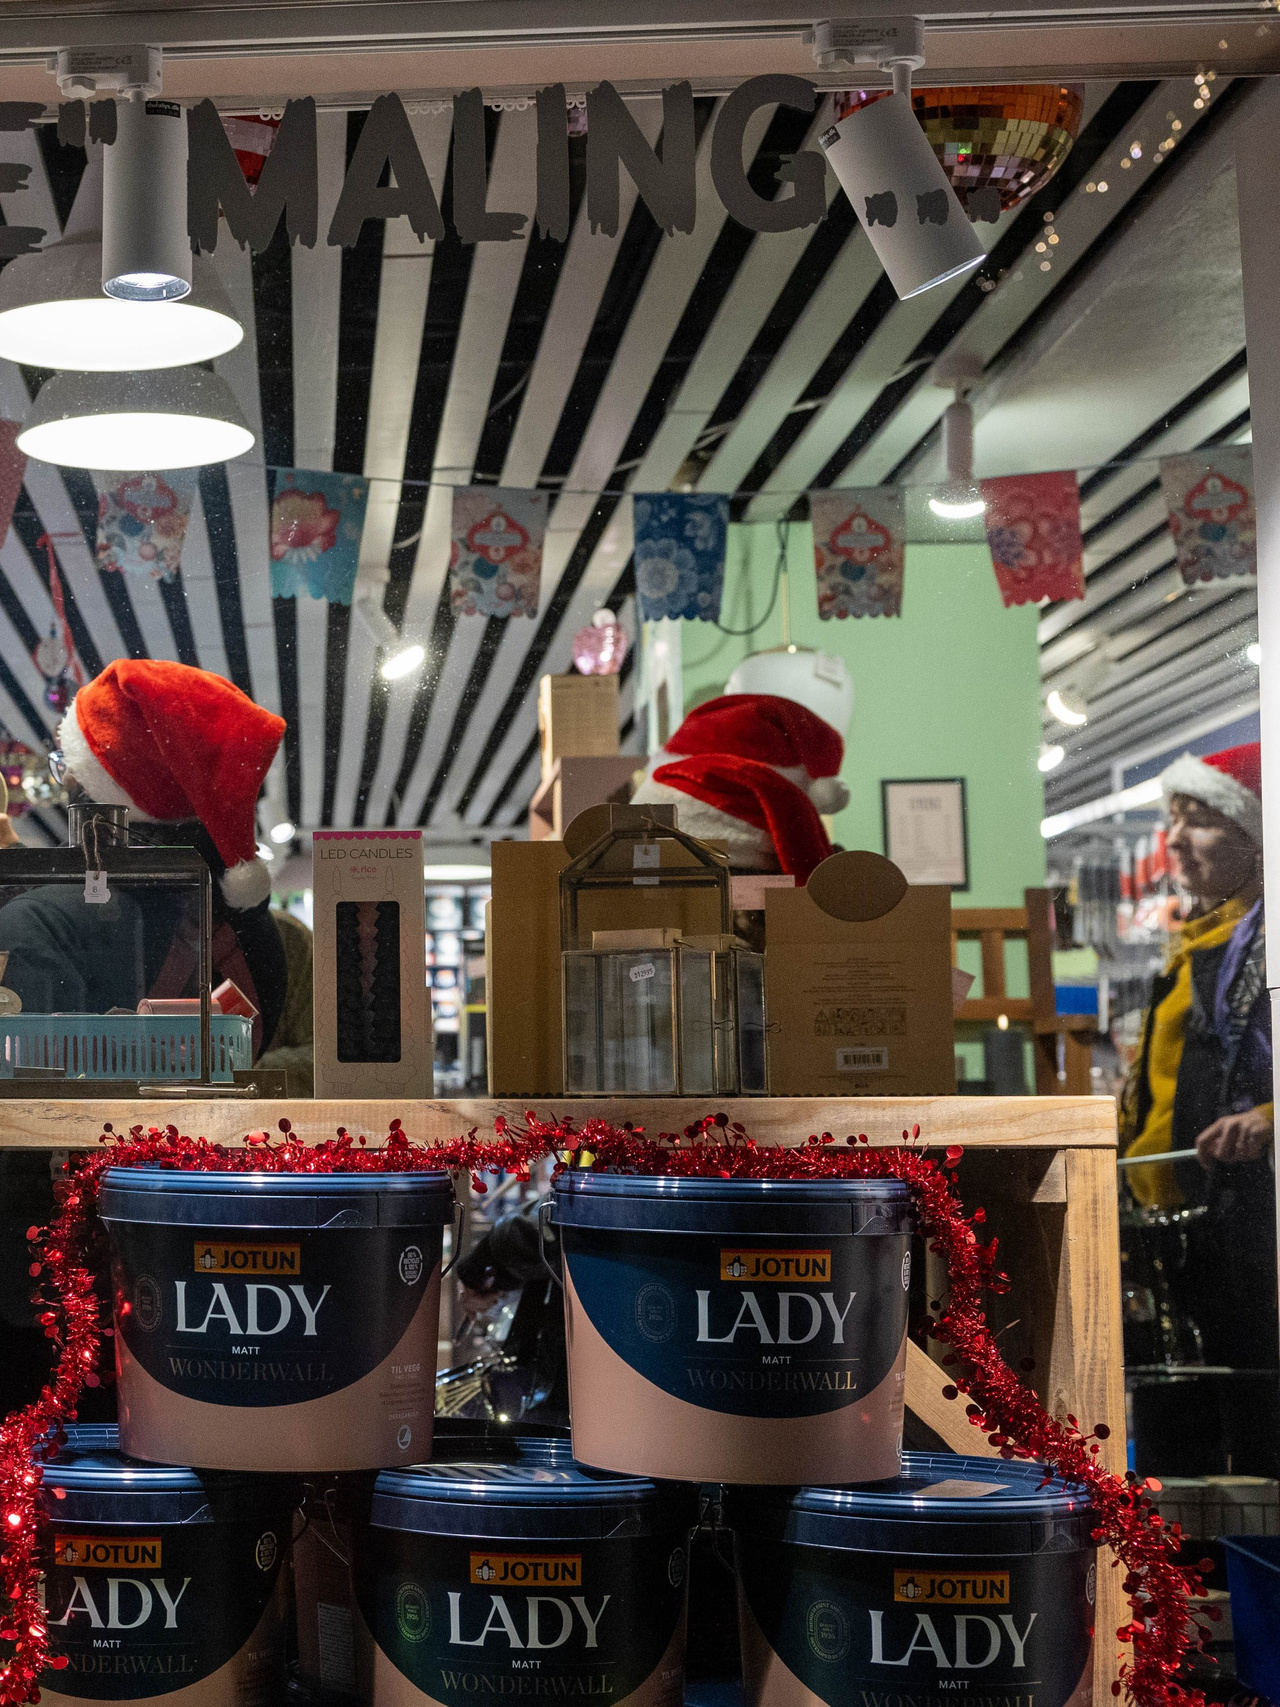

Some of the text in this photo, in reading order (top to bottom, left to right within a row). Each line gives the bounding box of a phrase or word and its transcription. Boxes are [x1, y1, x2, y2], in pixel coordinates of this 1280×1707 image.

[320, 848, 413, 860] LED CANDLES
[360, 865, 377, 874] rice
[220, 1249, 296, 1271] JOTUN
[750, 1257, 827, 1278] JOTUN
[174, 1280, 333, 1337] LADY
[695, 1289, 858, 1345] LADY
[231, 1345, 261, 1355] MATT
[761, 1355, 792, 1365] MATT
[168, 1357, 334, 1382] WONDERWALL
[391, 1363, 421, 1374] TIL VEGG
[686, 1367, 858, 1391] WONDERWALL
[82, 1544, 157, 1564] JOTUN
[500, 1561, 577, 1581] JOTUN
[925, 1578, 1006, 1600] JOTUN
[36, 1574, 193, 1630] LADY
[447, 1591, 612, 1649] LADY
[92, 1638, 122, 1649] MATT
[868, 1609, 1039, 1670] LADY
[42, 1652, 194, 1675] ONDERWALL
[511, 1659, 542, 1670] MATT
[440, 1669, 613, 1698] WONDERWALL
[938, 1679, 971, 1690] MATT
